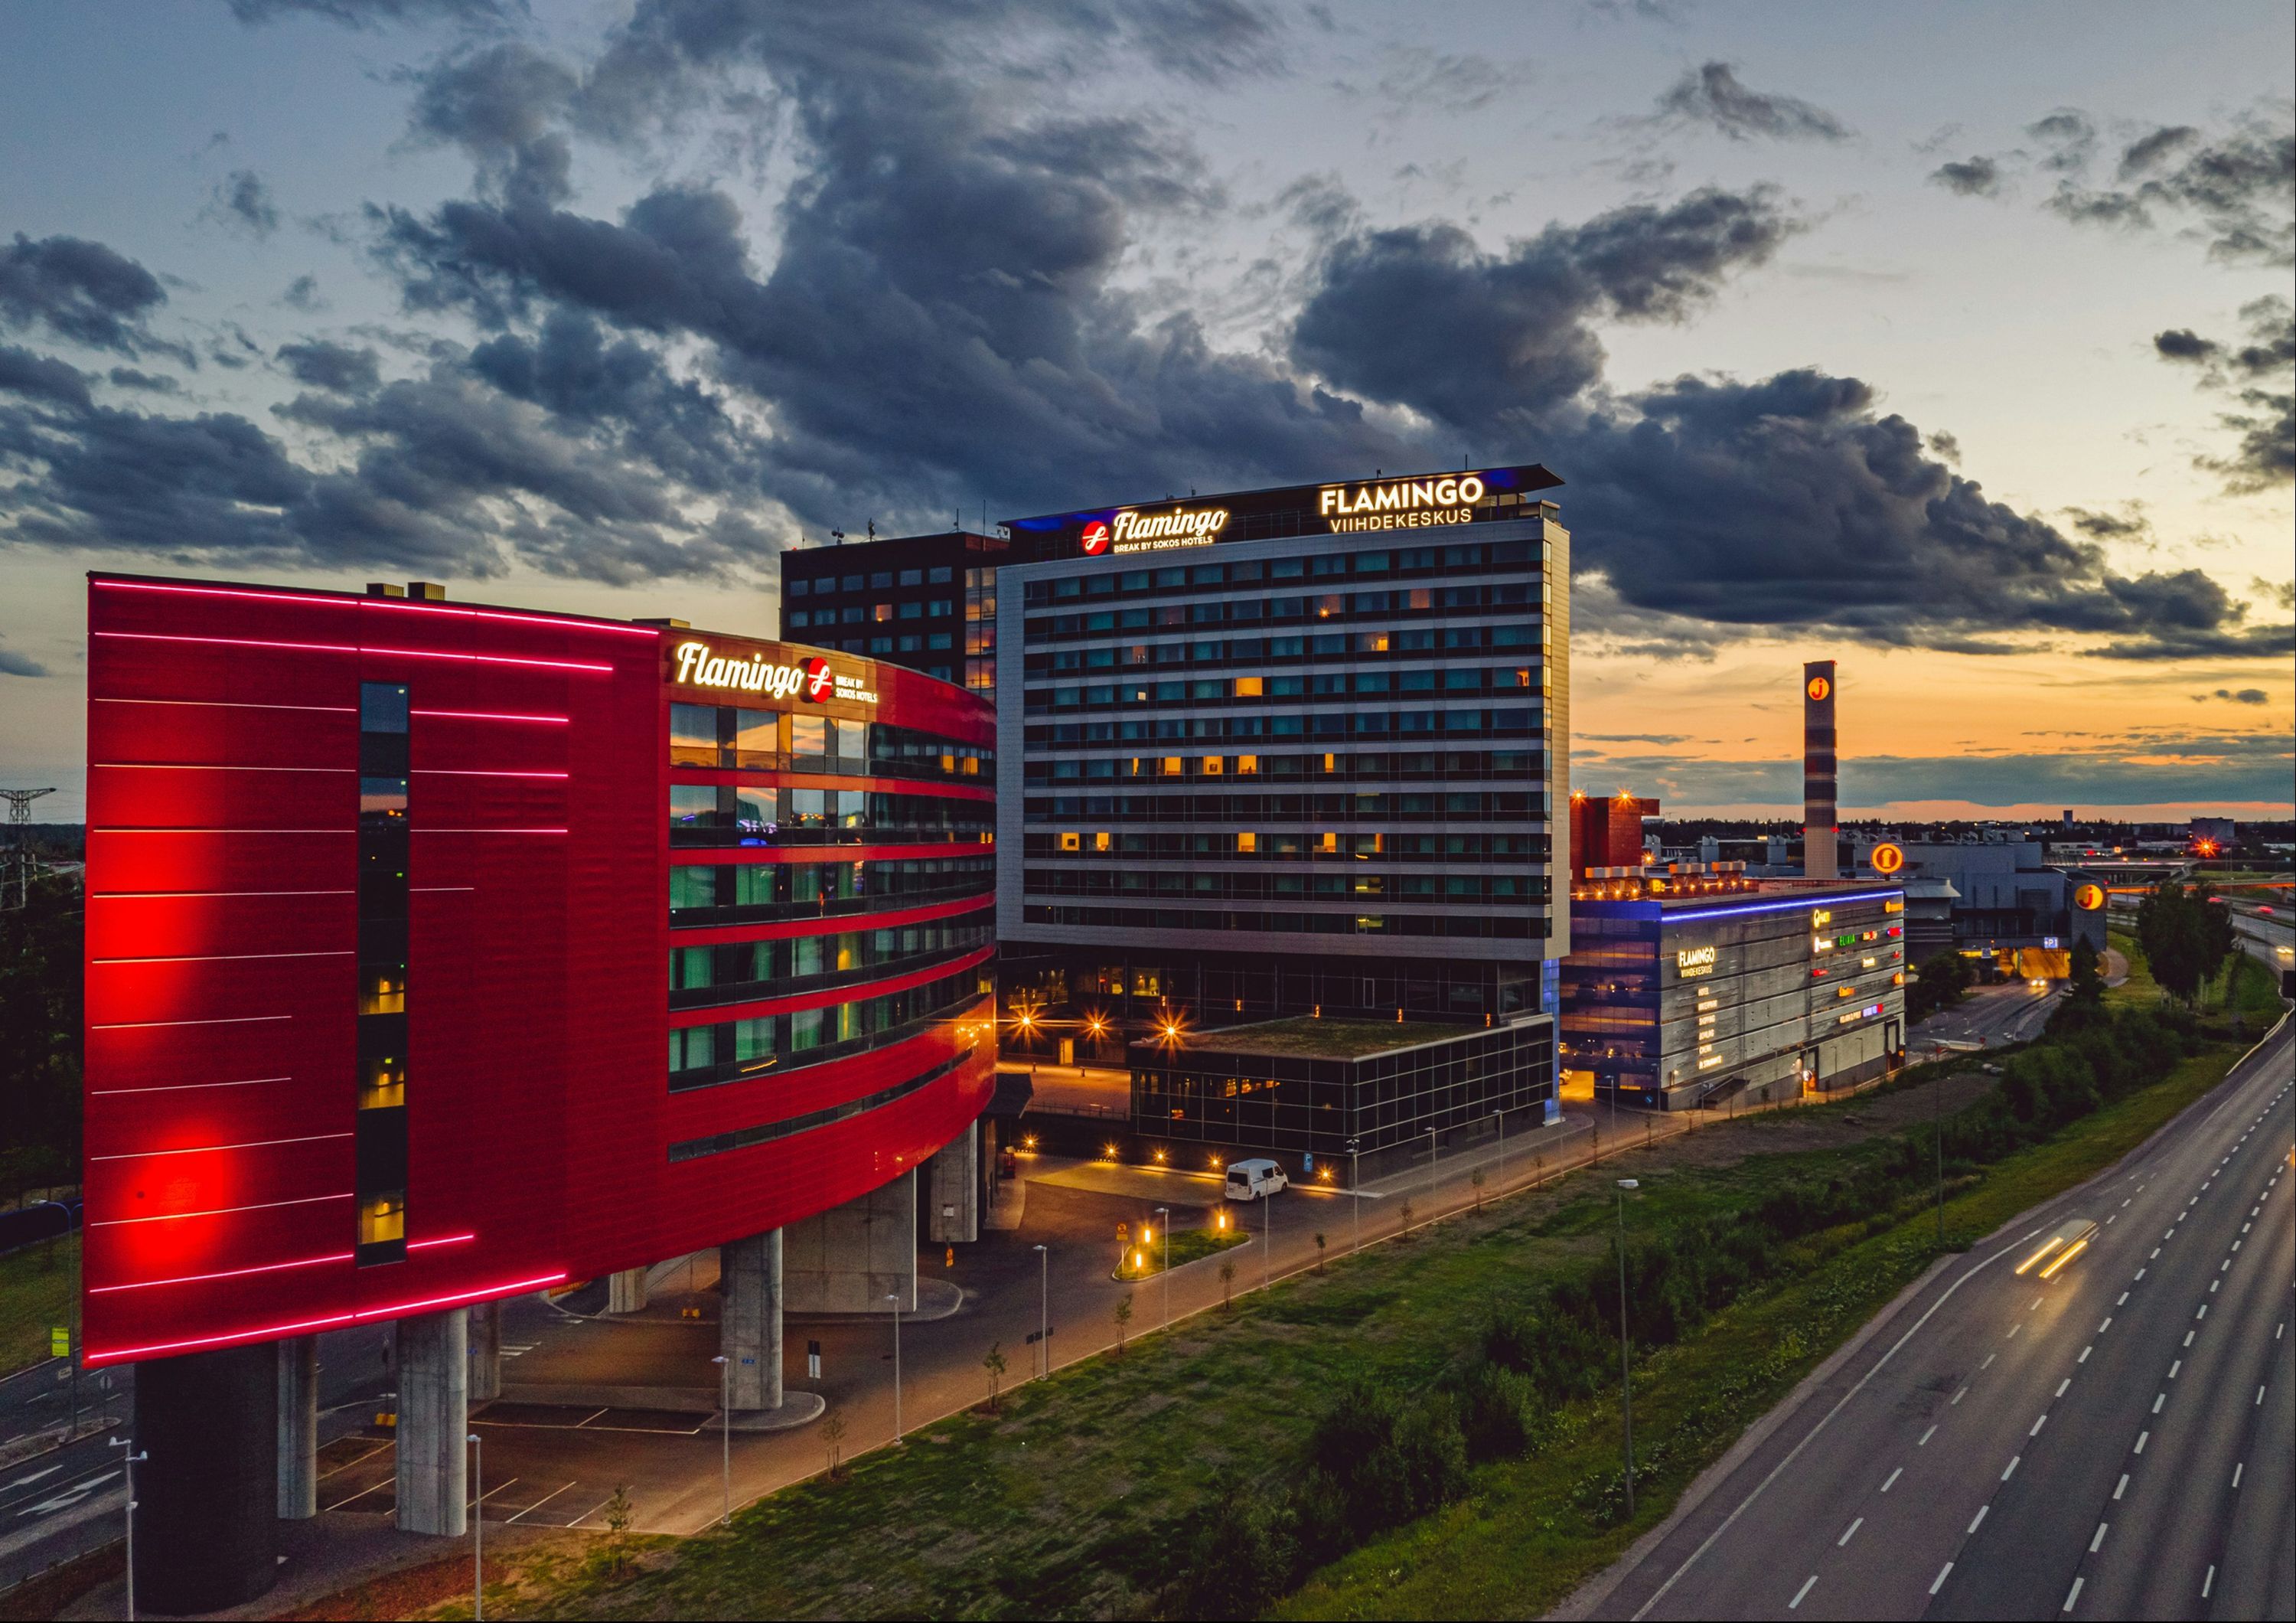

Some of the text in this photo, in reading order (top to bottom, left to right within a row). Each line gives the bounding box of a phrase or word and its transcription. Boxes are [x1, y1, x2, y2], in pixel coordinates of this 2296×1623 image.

[1321, 477, 1483, 514] FLAMINGO
[1114, 507, 1228, 541] Flamingo
[1330, 508, 1472, 533] VIIHDEKESKUS
[1114, 536, 1213, 554] BREAK BY SOKOS HOTELS
[677, 642, 805, 699] Flamingo
[836, 675, 864, 689] BREAK BY
[836, 687, 878, 704] SOKOS HOTELS
[2048, 938, 2057, 946] P1
[1678, 946, 1715, 968] FLAMINGO
